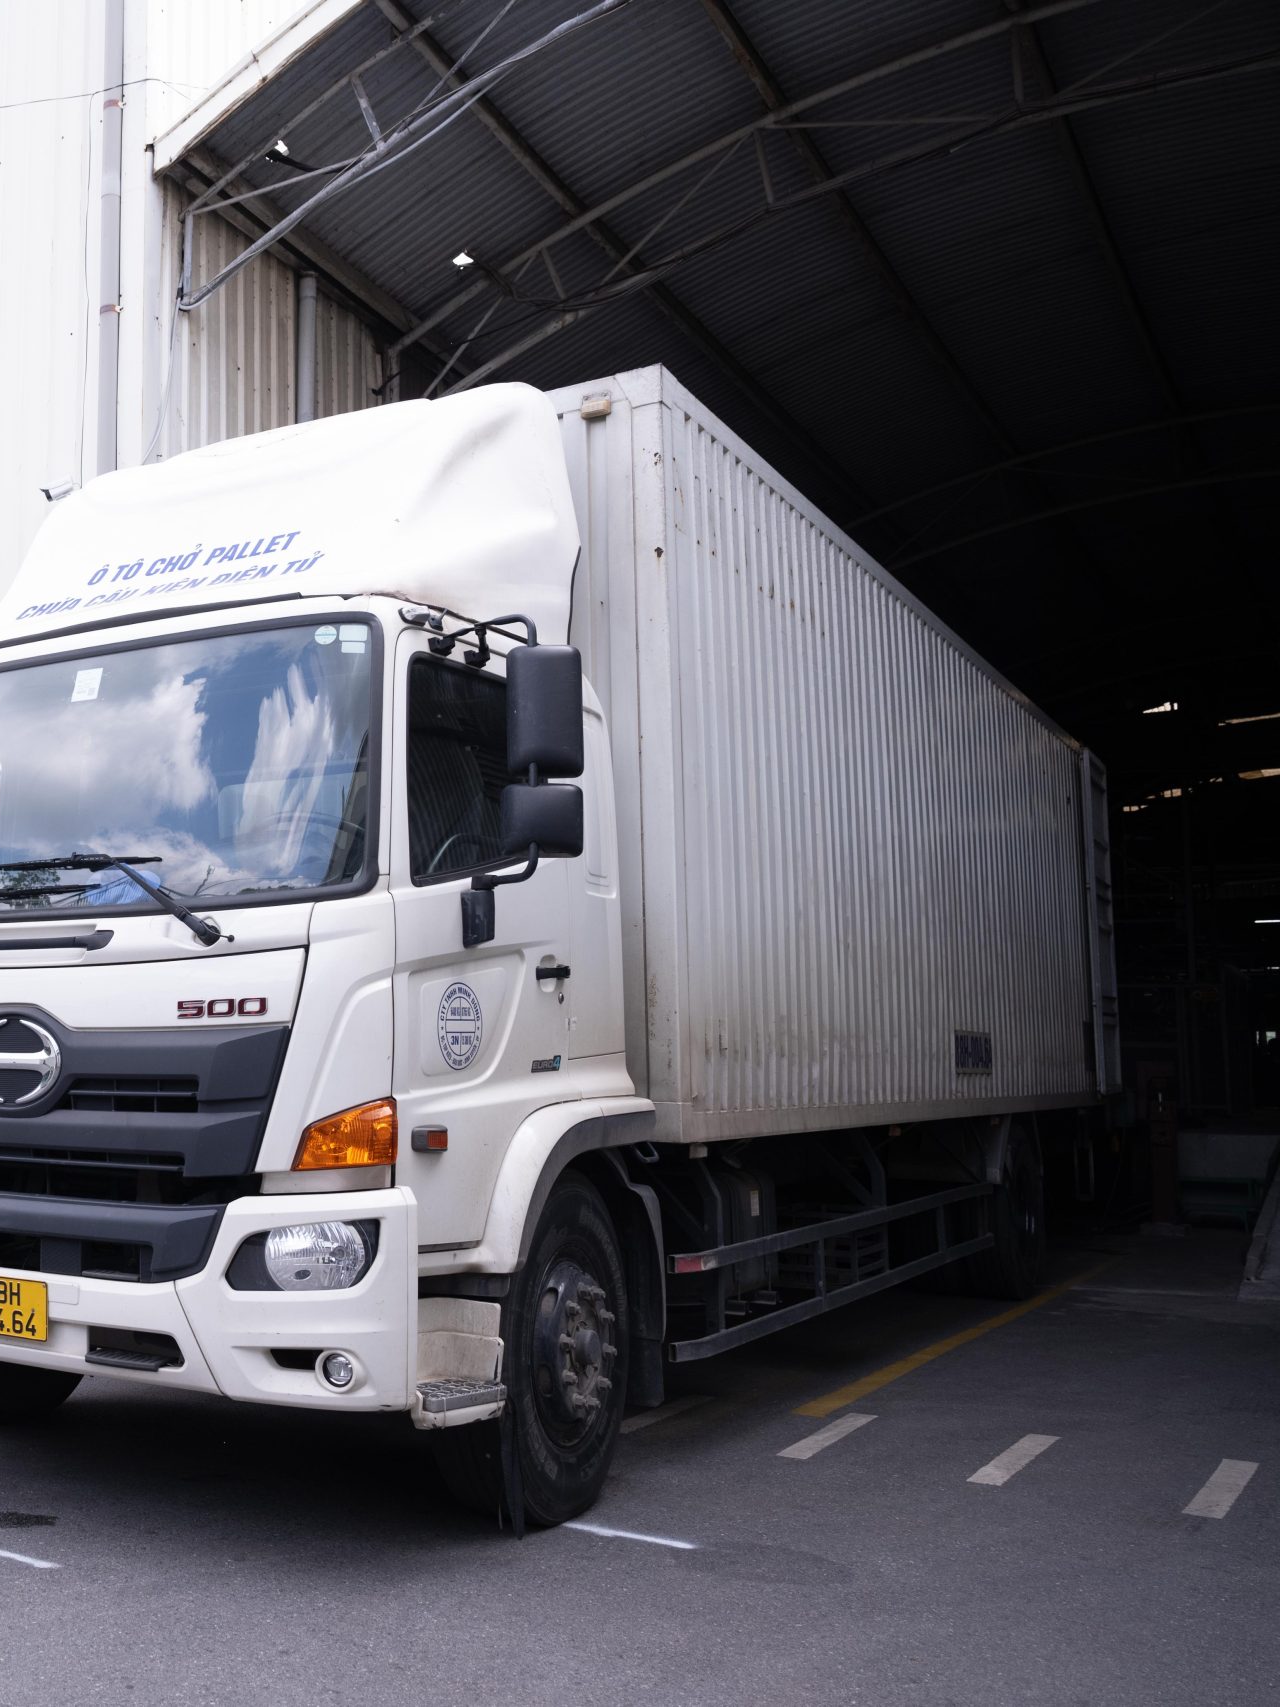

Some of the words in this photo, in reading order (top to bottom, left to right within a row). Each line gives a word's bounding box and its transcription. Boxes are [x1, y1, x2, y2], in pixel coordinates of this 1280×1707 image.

[88, 564, 110, 586] Ô
[110, 558, 144, 582] TÔ
[145, 544, 203, 576] CHỞ
[202, 531, 300, 566] PALLET
[177, 997, 268, 1019] 500
